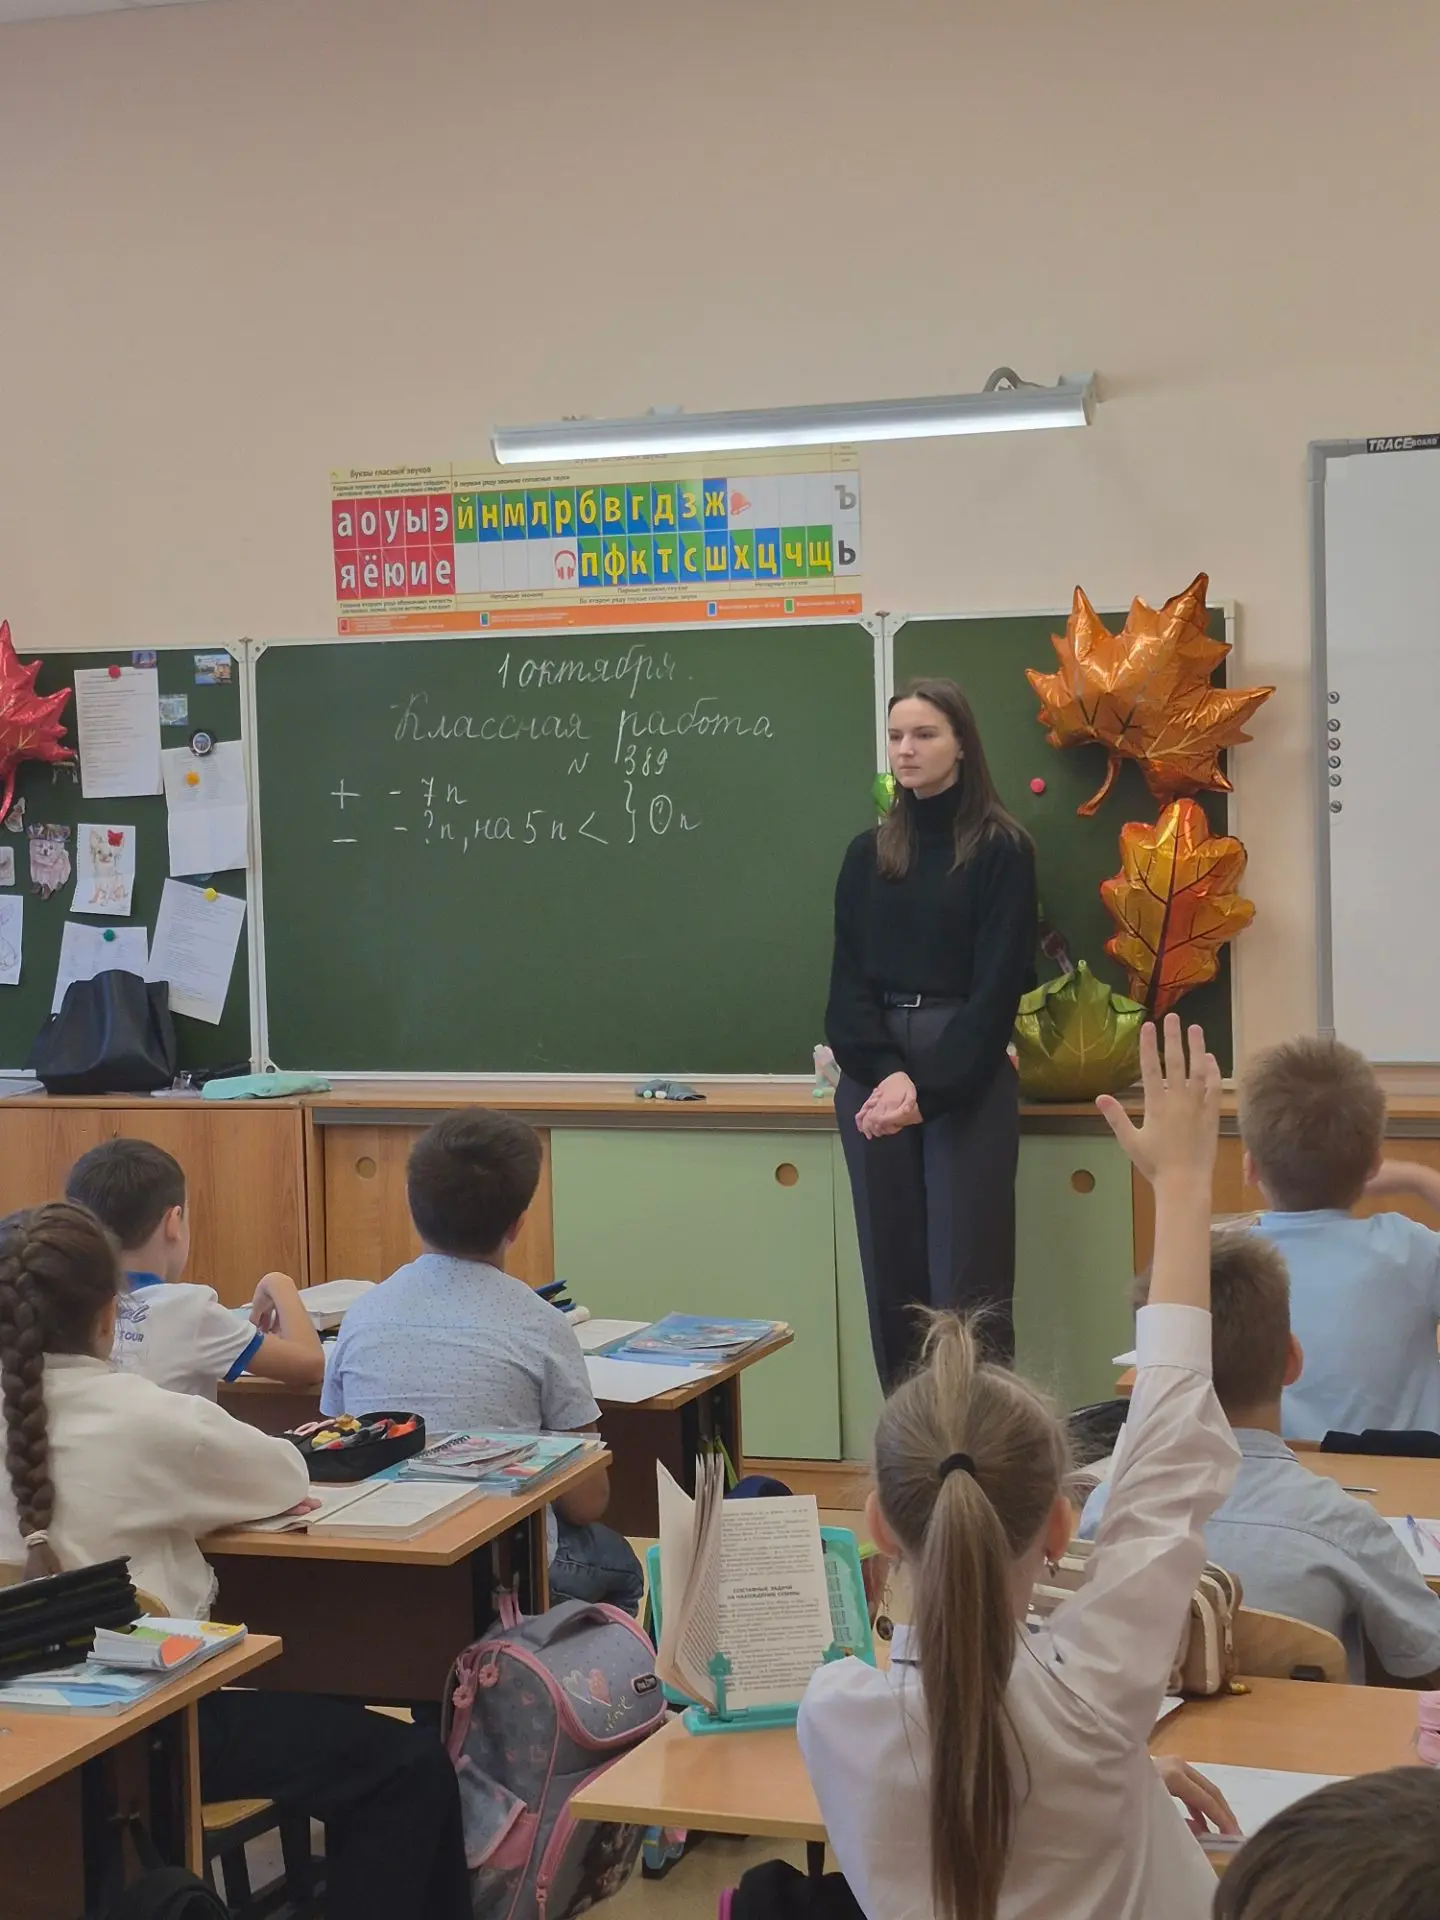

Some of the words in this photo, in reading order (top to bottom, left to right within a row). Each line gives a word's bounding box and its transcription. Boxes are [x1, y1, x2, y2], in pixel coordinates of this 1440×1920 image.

[389, 691, 592, 741] Классная
[613, 697, 774, 764] работа
[623, 743, 669, 777] 389
